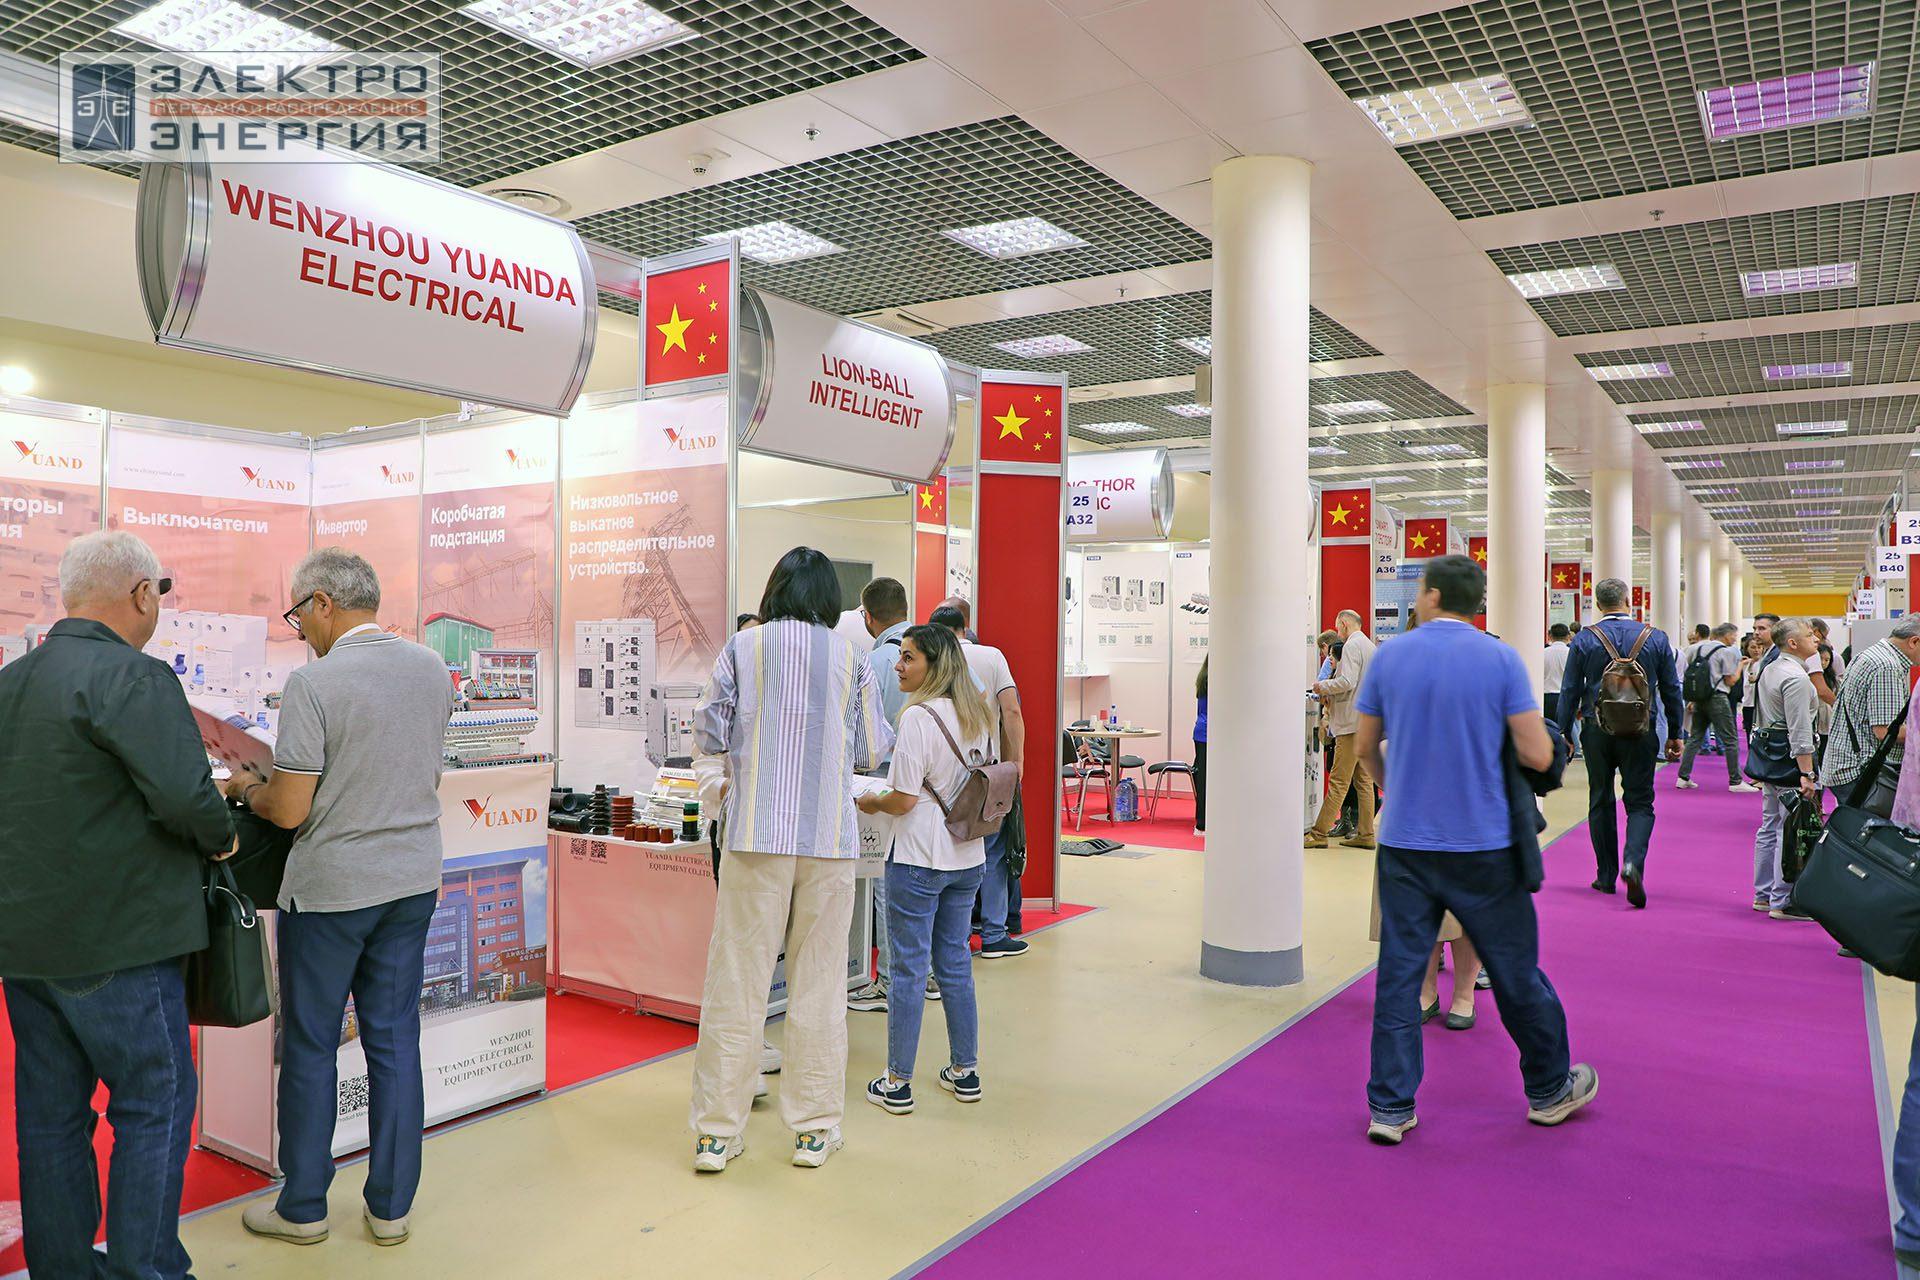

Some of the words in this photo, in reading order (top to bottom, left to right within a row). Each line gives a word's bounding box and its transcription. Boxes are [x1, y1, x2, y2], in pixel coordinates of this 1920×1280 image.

[221, 179, 430, 266] WENZHOU
[440, 242, 577, 306] YUANDA
[299, 247, 525, 333] ELECTRICAL
[821, 353, 914, 399] LION-BALL
[809, 380, 923, 429] INTELLIGENT
[570, 490, 679, 511] Низковольтное
[1072, 496, 1089, 506] 25
[123, 506, 269, 534] Выключатели
[431, 504, 506, 526] Коробчатая
[569, 516, 634, 533] выкатное
[1066, 514, 1093, 525] A32
[1909, 519, 1920, 528] 2
[316, 518, 368, 537] Инвертор
[430, 528, 505, 549] подстанция
[569, 534, 716, 558] распределительное
[1885, 552, 1901, 560] 25
[568, 558, 650, 582] устройство.
[1376, 566, 1395, 574] A36
[462, 792, 538, 833] YUAND
[675, 855, 712, 867] ELECTRICAL
[490, 1028, 533, 1047] WENZHOU
[438, 1058, 477, 1075] YUANDA
[480, 1041, 534, 1062] ELECTRICAL
[444, 1063, 498, 1086] EQUIPMENT
